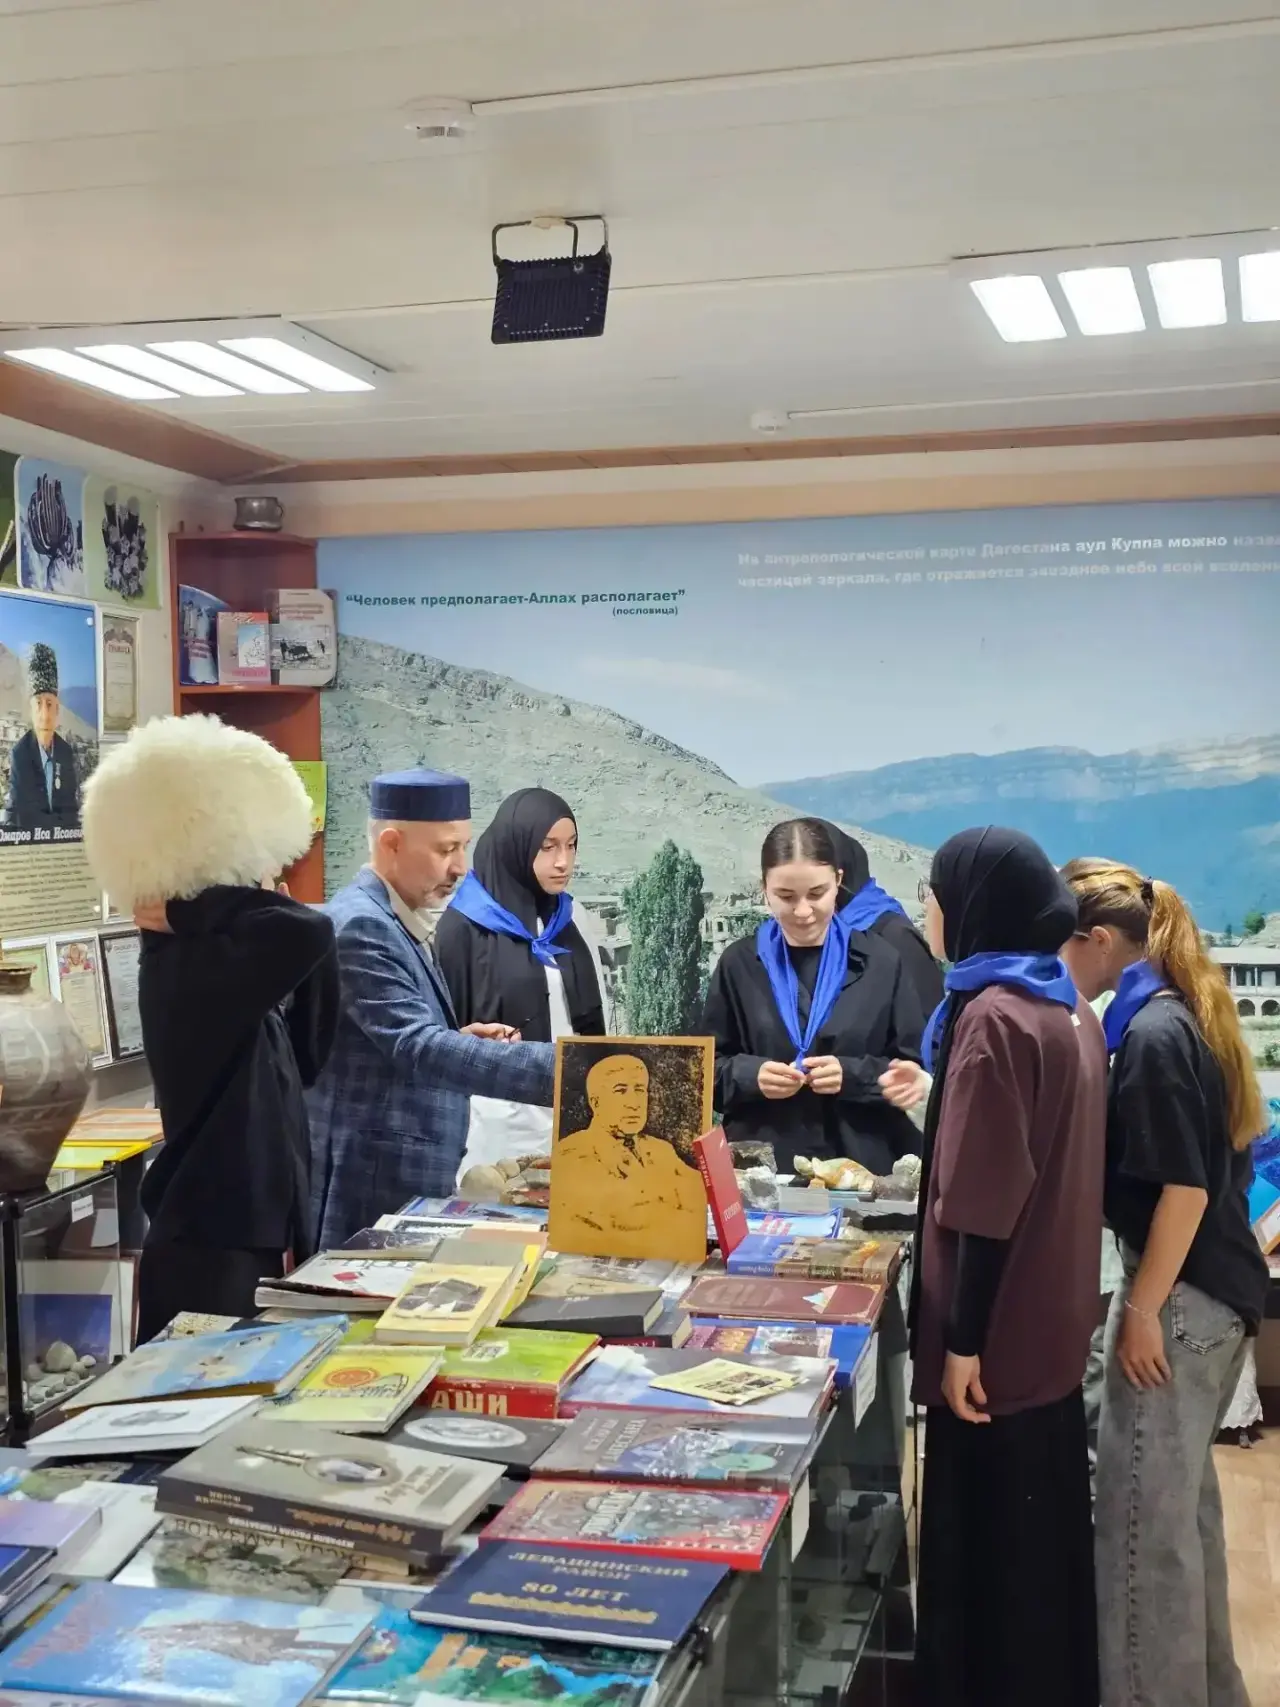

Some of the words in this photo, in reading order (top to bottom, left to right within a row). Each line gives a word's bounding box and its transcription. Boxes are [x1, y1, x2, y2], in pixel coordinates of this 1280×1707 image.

[981, 542, 1070, 560] Дагестана
[1076, 539, 1106, 553] аул
[1111, 537, 1163, 552] Куппа
[1168, 535, 1228, 549] можно
[738, 573, 812, 588] частицей
[895, 572, 922, 585] где
[927, 566, 1024, 583] отражается
[1116, 559, 1157, 574] небо
[420, 591, 577, 608] предполагает-Аллах
[581, 588, 685, 606] располагает”
[612, 605, 678, 616] (пословица)
[53, 826, 83, 840] Исаеви
[508, 1551, 690, 1577] ЛЕВАШИНСКИЙ
[553, 1564, 631, 1581] РАЙОН
[521, 1581, 559, 1595] 80
[564, 1586, 630, 1602] ЛЕТ
